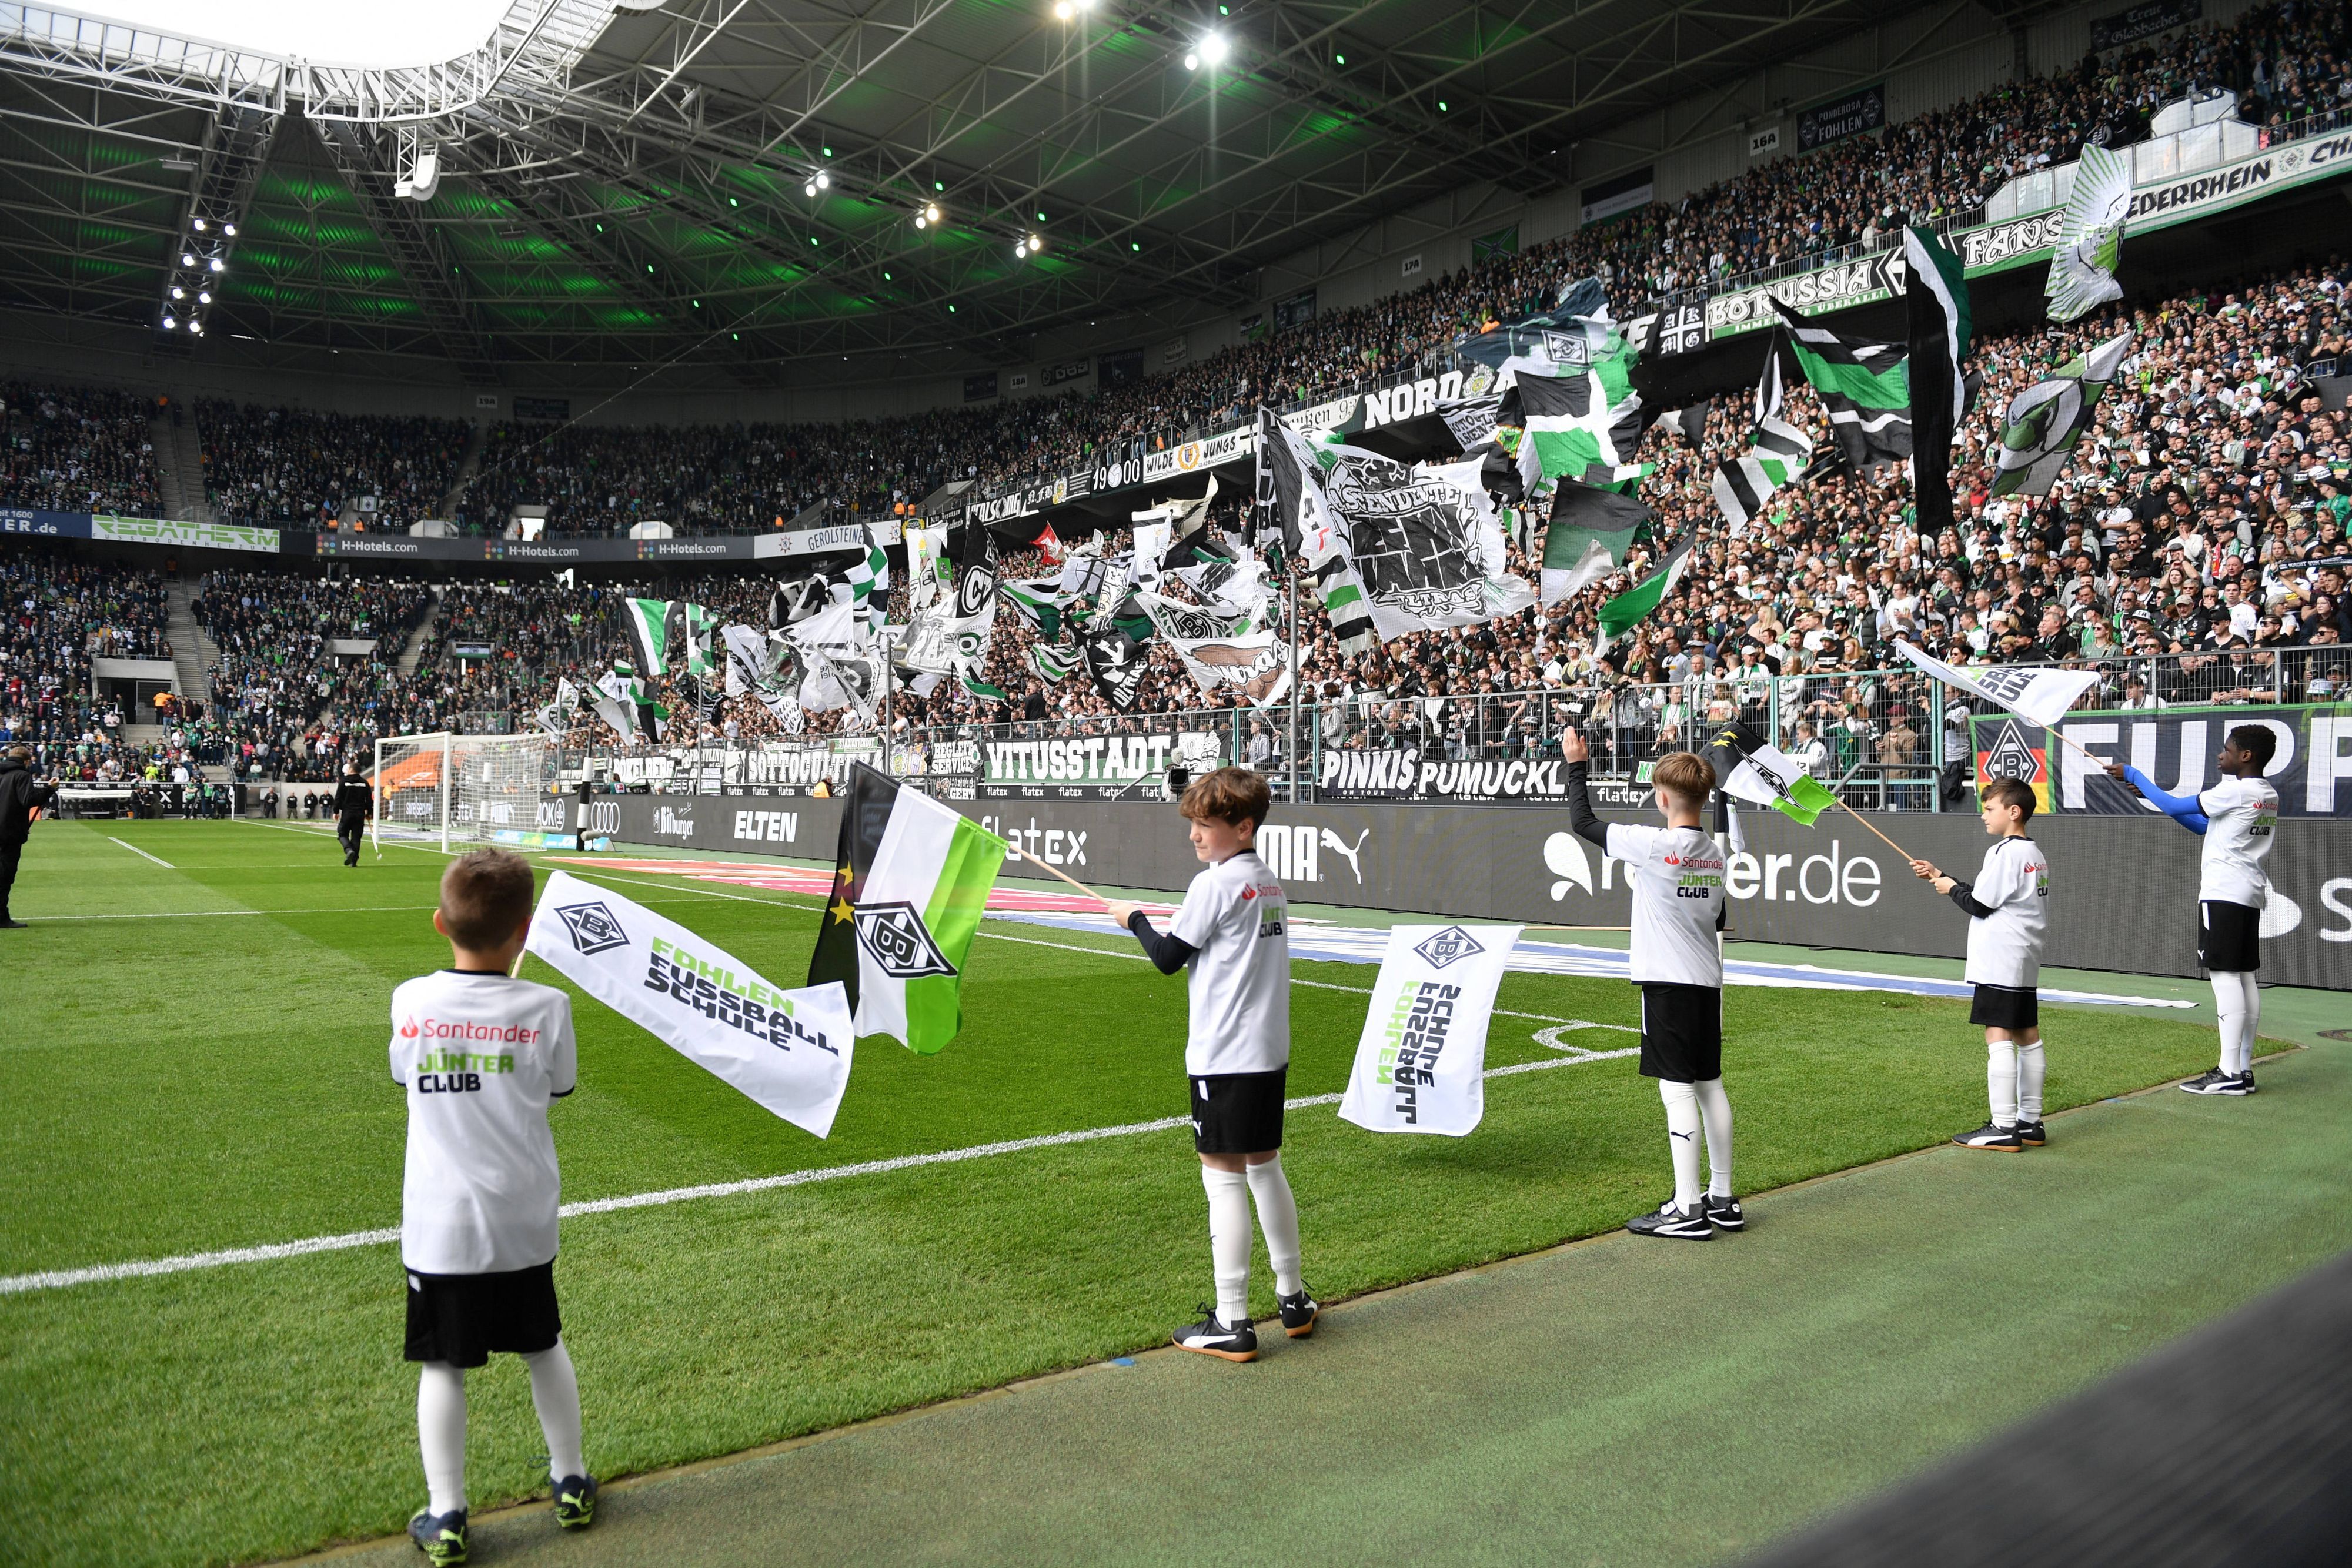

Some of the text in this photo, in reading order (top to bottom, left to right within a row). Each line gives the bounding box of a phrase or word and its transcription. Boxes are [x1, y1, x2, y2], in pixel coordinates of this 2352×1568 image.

[1819, 115, 1863, 142] FOHLEN
[1752, 133, 1776, 149] 16A
[1404, 259, 1420, 273] 17A
[1709, 260, 1873, 329] BORUSSIA
[1011, 377, 1026, 387] 18A
[1364, 369, 1464, 430] NORD
[1146, 435, 1237, 474] WILDE JUNGS
[12, 510, 33, 519] 1600
[93, 515, 279, 546] REGATHERM
[342, 540, 418, 553] H-Hotels.com
[509, 546, 579, 557] H-Hotels.com
[659, 542, 726, 555] H-Hotels.com
[933, 740, 974, 760] BEGLEIT
[985, 735, 1171, 781] VITUSSTADT
[931, 755, 974, 774] SERVICE
[1321, 748, 1418, 790] PINKIS
[1418, 760, 1566, 795] PUMUCKL
[727, 786, 743, 795] flatex
[753, 786, 769, 796] flatex
[778, 786, 795, 796] flatex
[987, 787, 1008, 797] flatex
[1021, 787, 1044, 797] flatex
[1058, 787, 1083, 797] flatex
[1141, 786, 1158, 798] flat
[535, 802, 556, 826] AOK
[660, 805, 694, 840] Bitburger
[734, 810, 798, 843] ELTEN
[1256, 824, 1319, 882] MA
[1678, 871, 1722, 887] JÜNTER
[1676, 886, 1709, 898] CLUB
[652, 936, 795, 1017] FOHLEN
[643, 967, 791, 1052] SCHULE
[650, 952, 840, 1057] FUSSBALL
[423, 1019, 541, 1045] Santander
[417, 1048, 515, 1074] JÜNTER
[418, 1073, 482, 1094] CLUB
